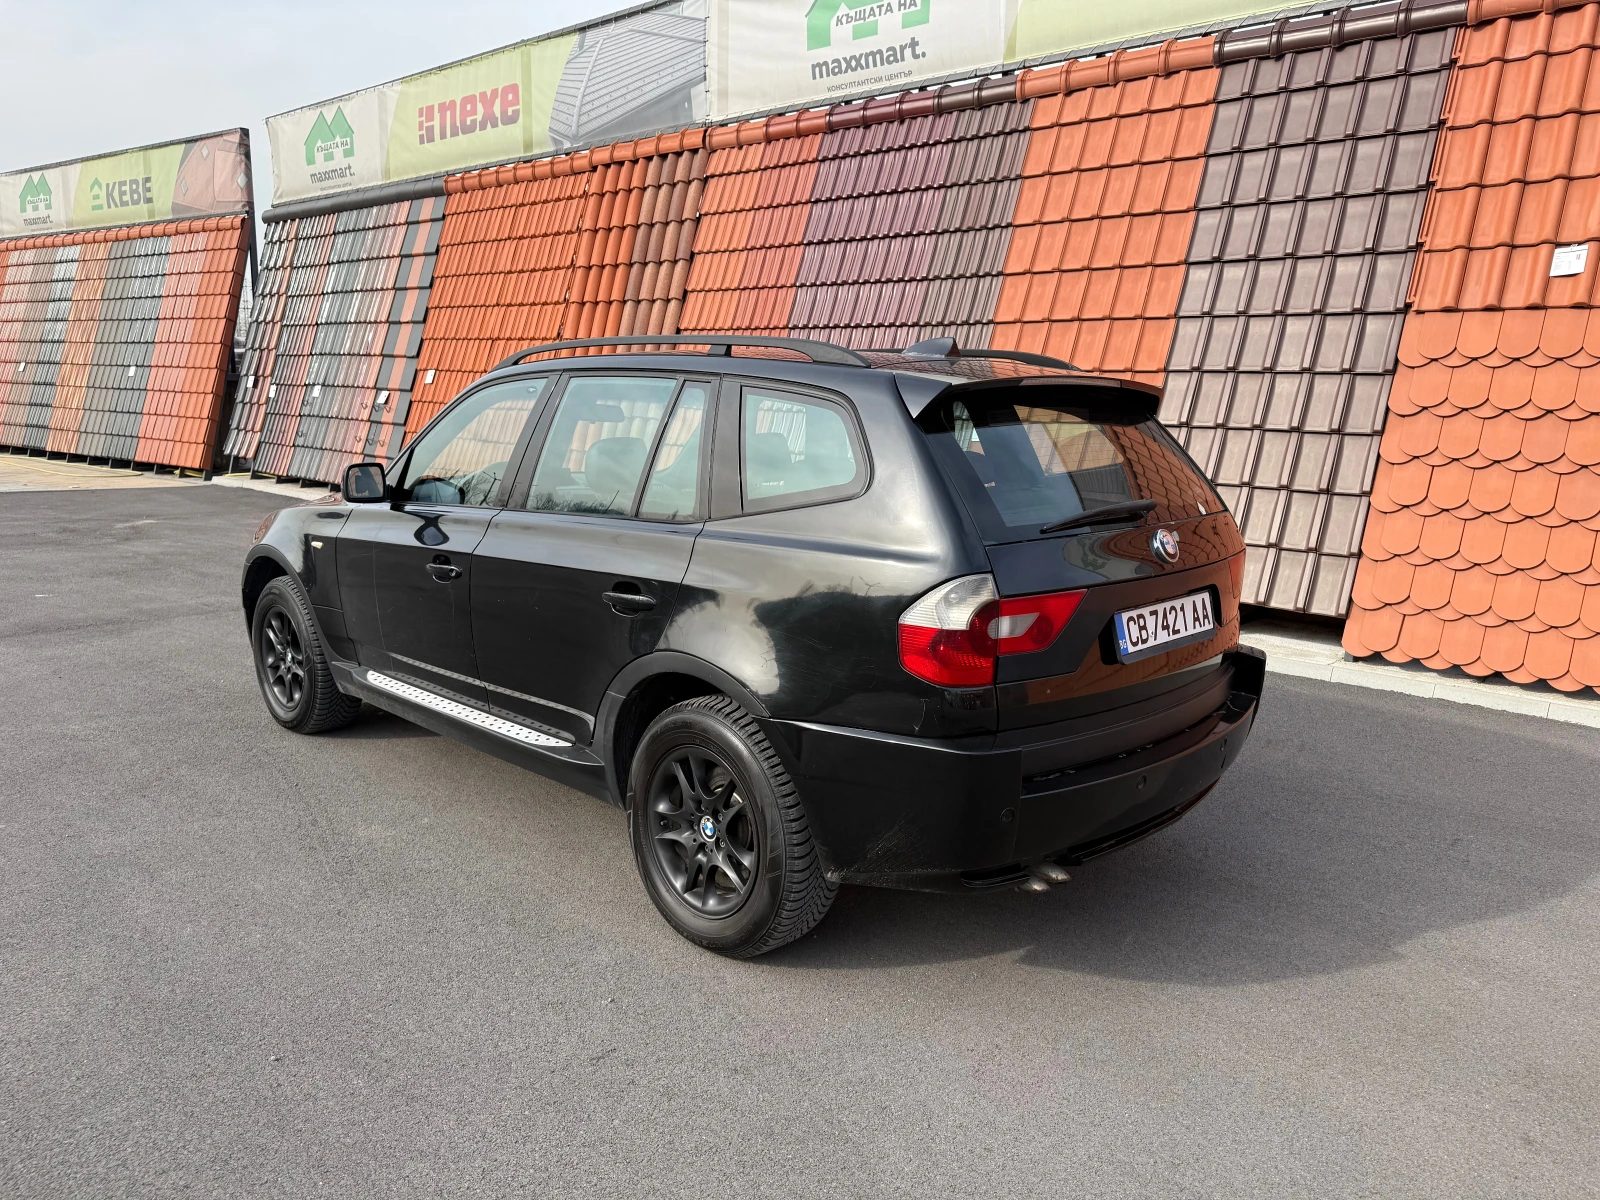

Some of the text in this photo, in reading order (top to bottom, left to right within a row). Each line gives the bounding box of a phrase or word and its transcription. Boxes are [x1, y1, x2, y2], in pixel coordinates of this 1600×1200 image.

[835, 0, 918, 26] КЪЩАТА НА
[811, 36, 926, 80] maxxmart.
[826, 70, 913, 93] КОНСУЛТАНТСКИ ЦЕНТЪР
[437, 83, 520, 139] nexe
[316, 139, 349, 153] КЪЩАТА НА
[310, 163, 356, 184] maxxmart.
[105, 176, 153, 208] KEBE
[1149, 602, 1188, 641] 7421
